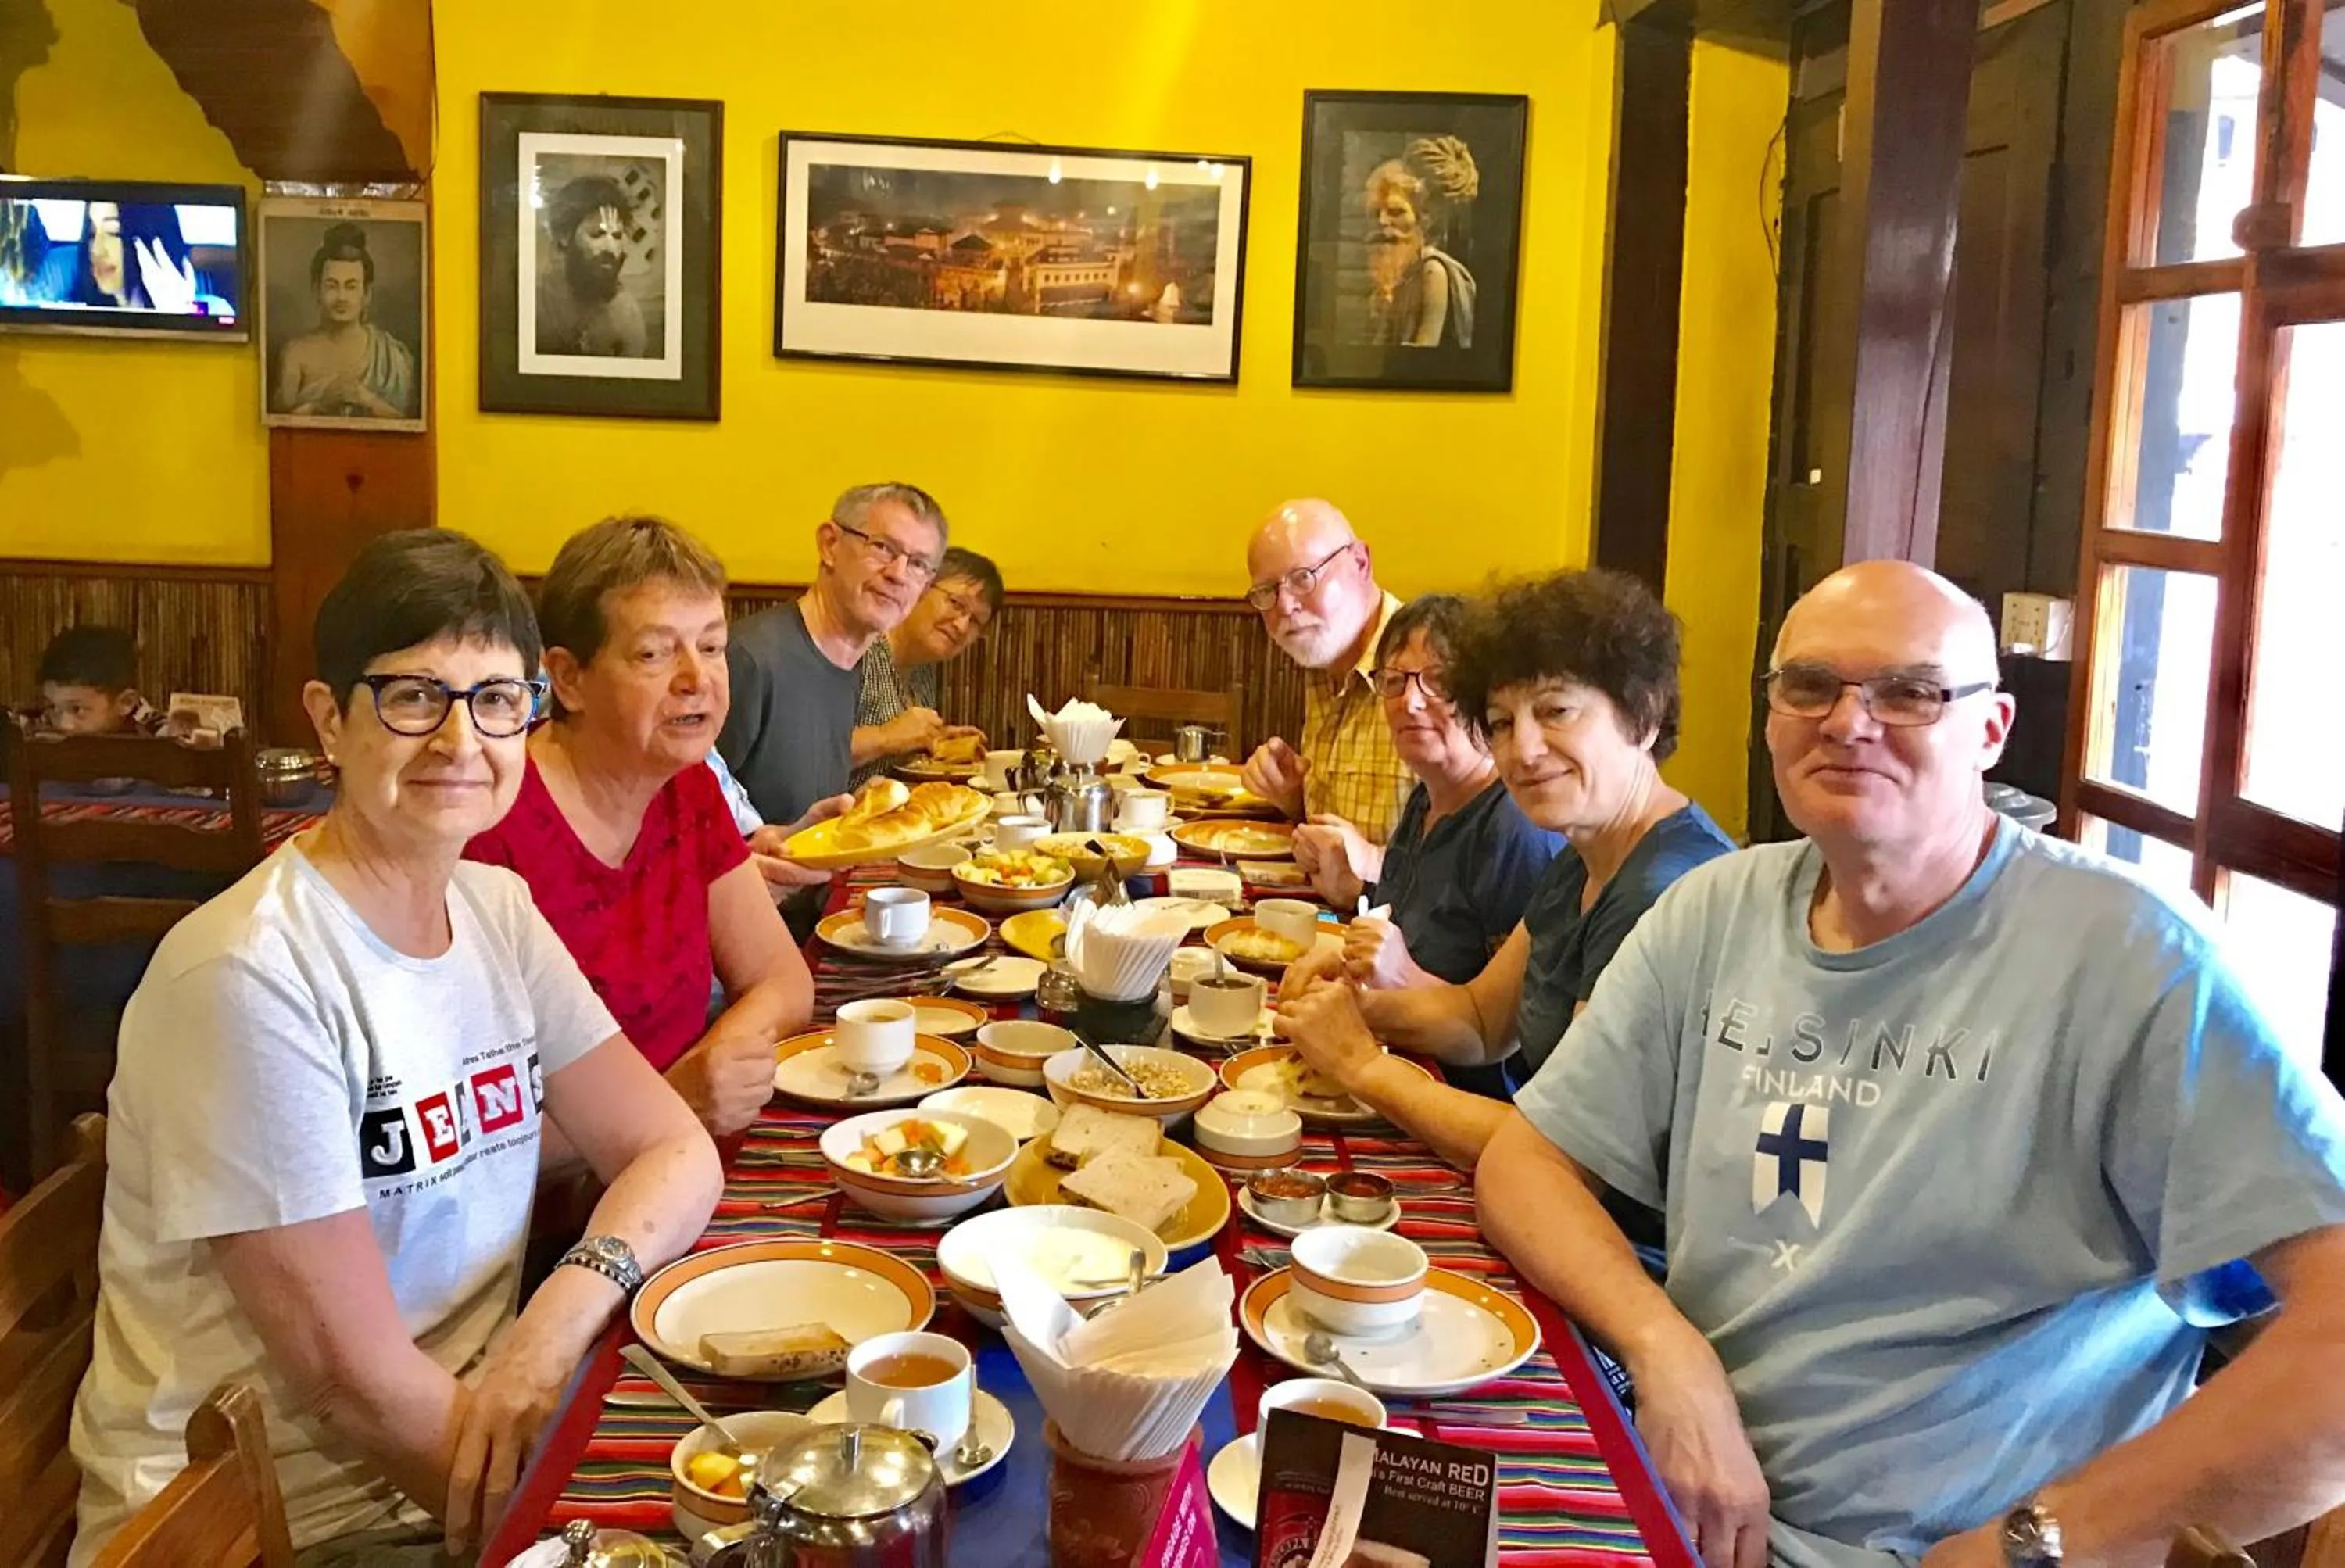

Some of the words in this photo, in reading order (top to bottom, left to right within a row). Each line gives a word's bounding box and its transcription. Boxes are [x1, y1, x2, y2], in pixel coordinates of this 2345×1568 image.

[1742, 1065, 1881, 1107] FINLAND
[379, 1178, 437, 1199] MATRIX
[1448, 1462, 1489, 1487] RED
[1417, 1477, 1445, 1494] Craft
[1449, 1484, 1484, 1502] BEER
